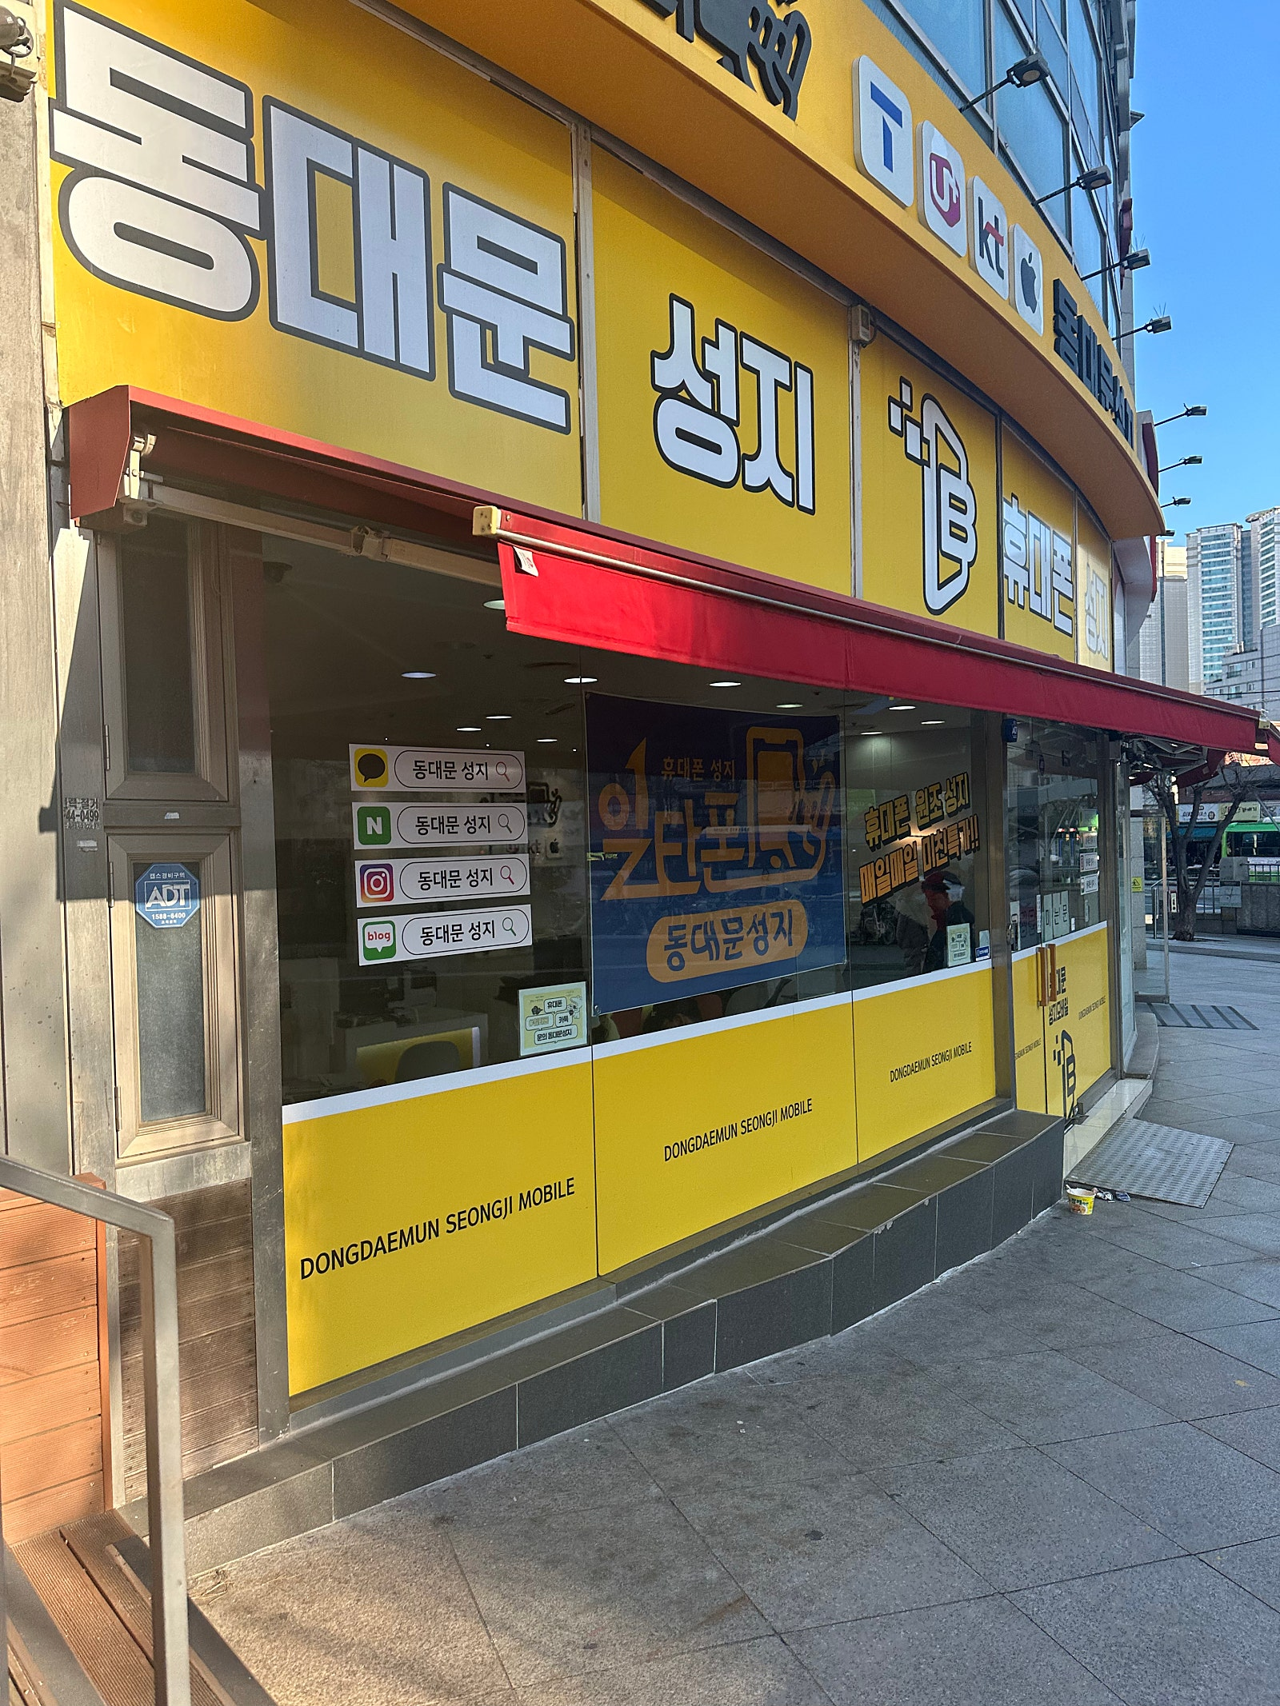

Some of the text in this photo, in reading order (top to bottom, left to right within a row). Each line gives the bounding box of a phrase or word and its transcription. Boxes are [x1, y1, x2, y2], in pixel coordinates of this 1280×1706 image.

[870, 81, 902, 173] T
[48, 1, 815, 515] 동대문 성지
[977, 196, 1004, 280] kt
[1002, 492, 1108, 661] 휴대폰 성지
[413, 760, 489, 781] 동대문 성지
[661, 756, 736, 782] 휴대폰 성지
[366, 817, 383, 835] N
[415, 815, 491, 836] 동대문 성지
[864, 772, 970, 850] 휴대폰 원조 성지
[417, 868, 493, 891] 동대문 성지
[859, 814, 980, 906] 매일매일 미친특가!!
[146, 884, 190, 908] ADT
[152, 912, 186, 920] 1588-6400
[367, 931, 391, 943] blog
[420, 920, 495, 946] 동대문 성지
[663, 909, 793, 972] 동대문성지
[889, 1057, 931, 1083] DONGDAEMUN
[953, 1041, 972, 1059] MOBILE
[664, 1098, 813, 1162] DONGDAEMUN SEONGJI MOBILE
[300, 1176, 576, 1280] DONGDAEMUN SEONGJI MOBILE
